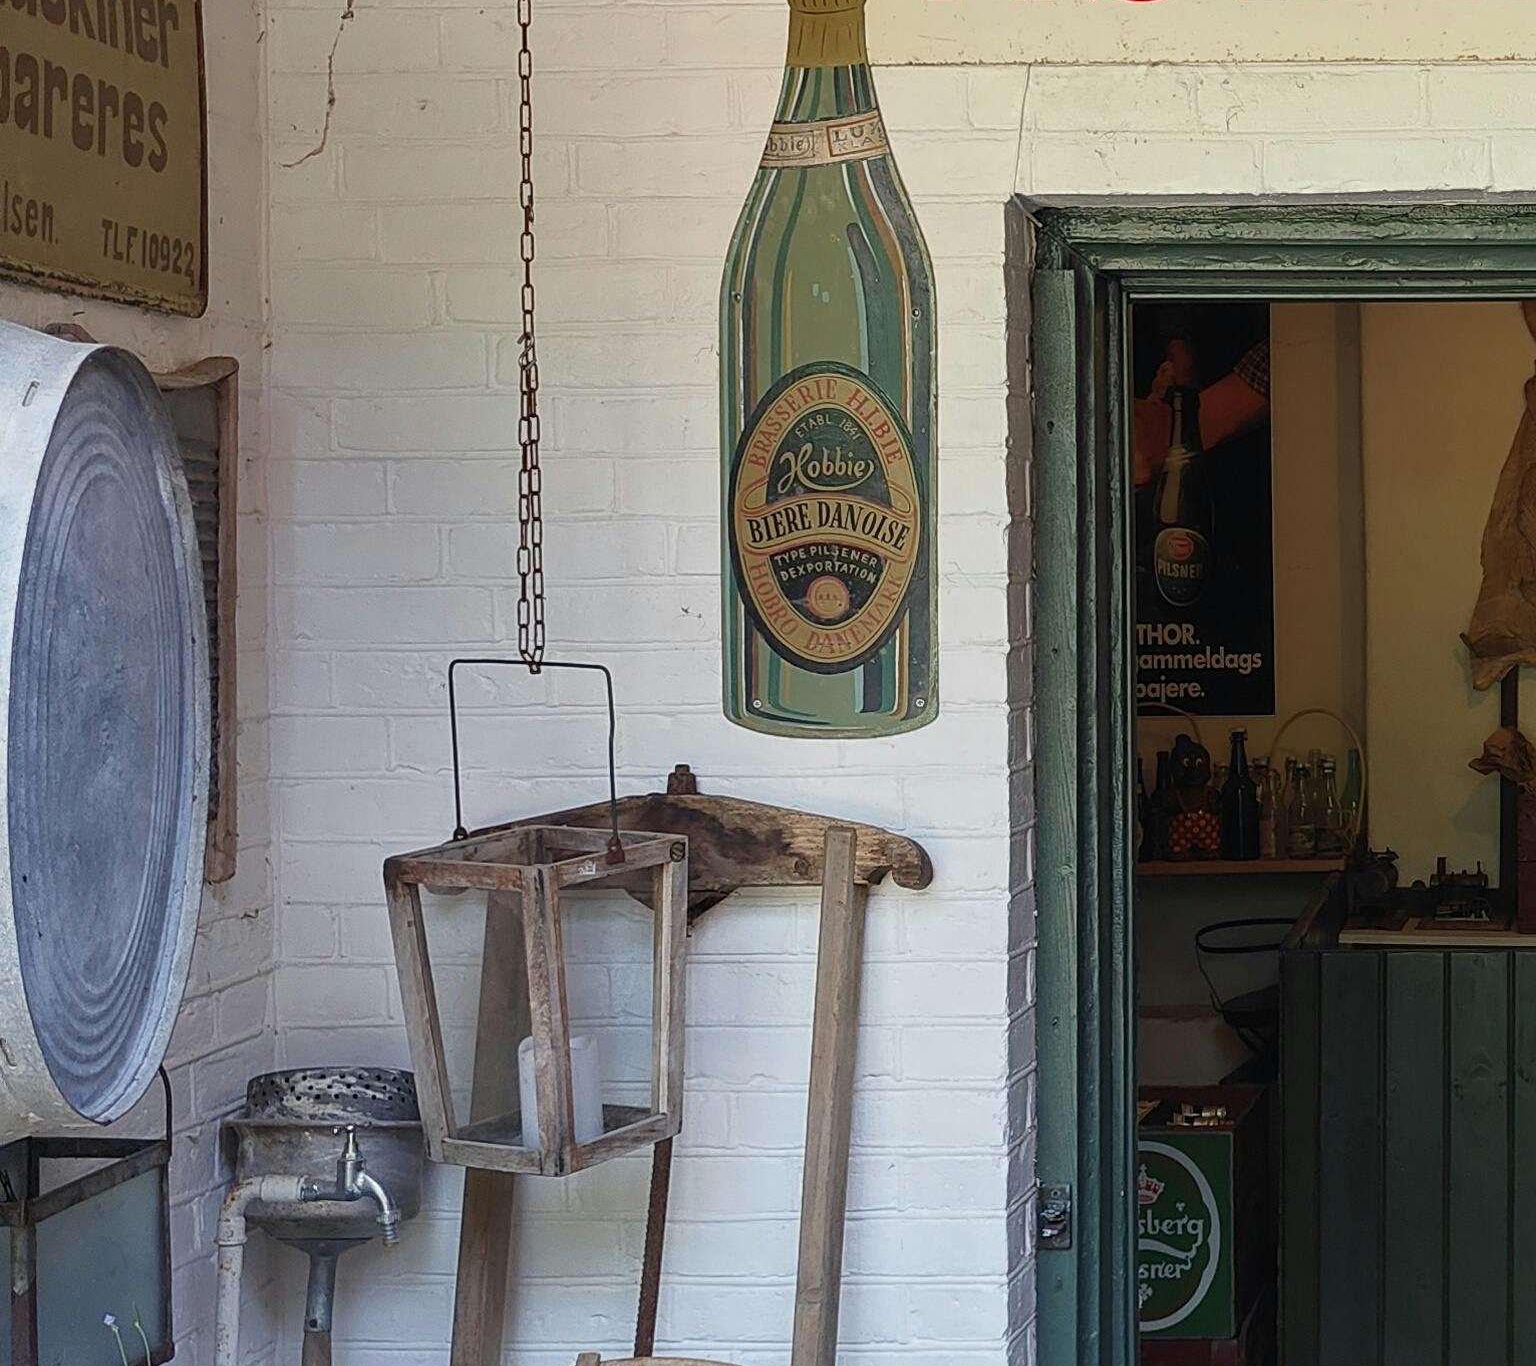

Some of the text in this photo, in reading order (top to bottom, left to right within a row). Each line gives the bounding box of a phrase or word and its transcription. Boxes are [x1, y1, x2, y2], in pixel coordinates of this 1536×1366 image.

[747, 378, 838, 467] BRASSERIE
[777, 442, 874, 494] Hobbie
[747, 501, 911, 551] BIERE DANOISE
[774, 546, 878, 568] TYPE PILSENER
[750, 562, 798, 635] HOBRO
[1136, 623, 1200, 645] THOR.
[1136, 646, 1262, 675] ammeldags
